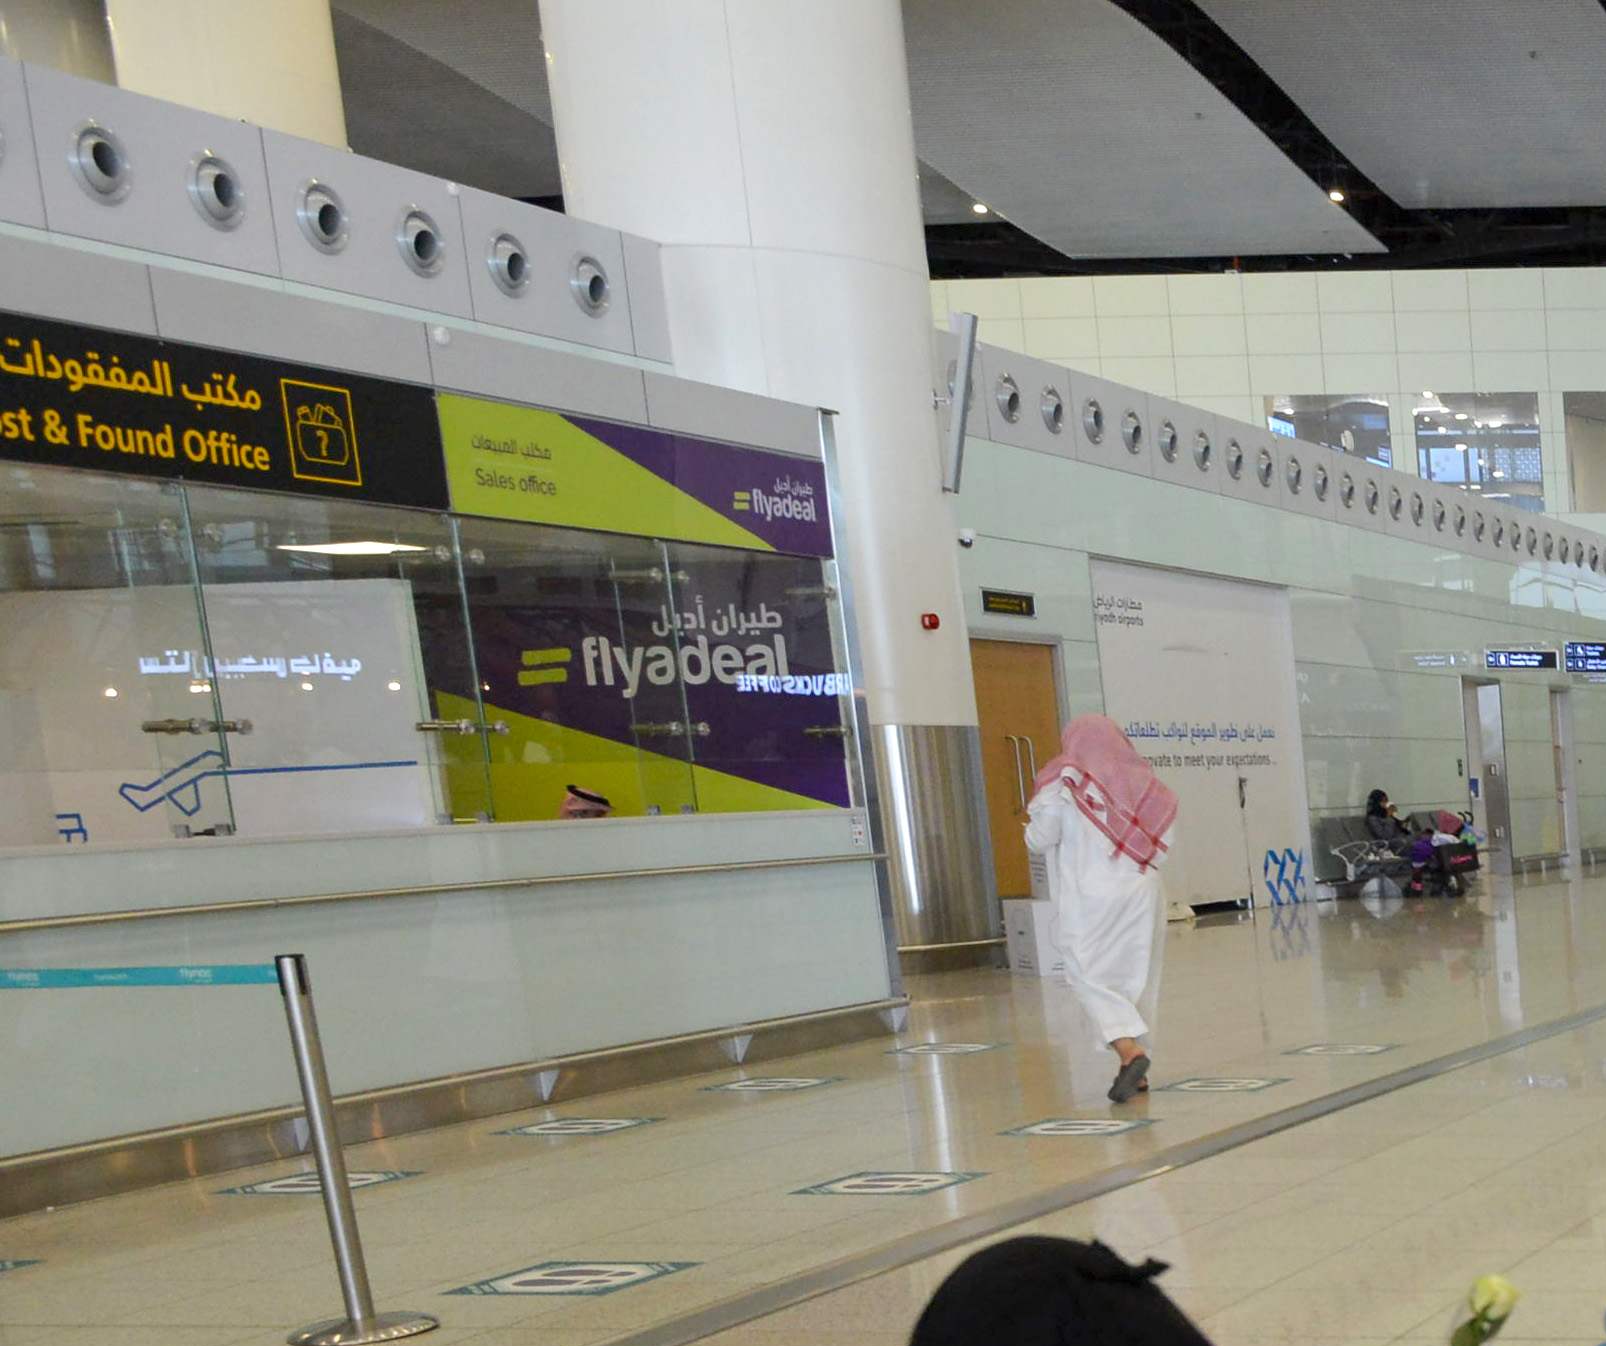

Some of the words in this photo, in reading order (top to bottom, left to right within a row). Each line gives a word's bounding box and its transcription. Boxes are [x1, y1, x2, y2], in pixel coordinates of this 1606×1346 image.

[0, 337, 174, 397] المفقودات
[181, 372, 261, 411] مكتب
[0, 406, 35, 442] st
[43, 409, 70, 445] &
[76, 413, 175, 459] Found
[182, 429, 271, 471] Office
[475, 467, 516, 491] Sales
[519, 475, 557, 497] office
[752, 487, 817, 523] flyadeal
[652, 595, 705, 637] أديل
[711, 601, 783, 637] طيران
[581, 633, 790, 699] flyadeal
[1174, 756, 1182, 767] to
[1184, 755, 1205, 767] meet
[1207, 756, 1224, 770] your
[1226, 754, 1271, 770] expectations
